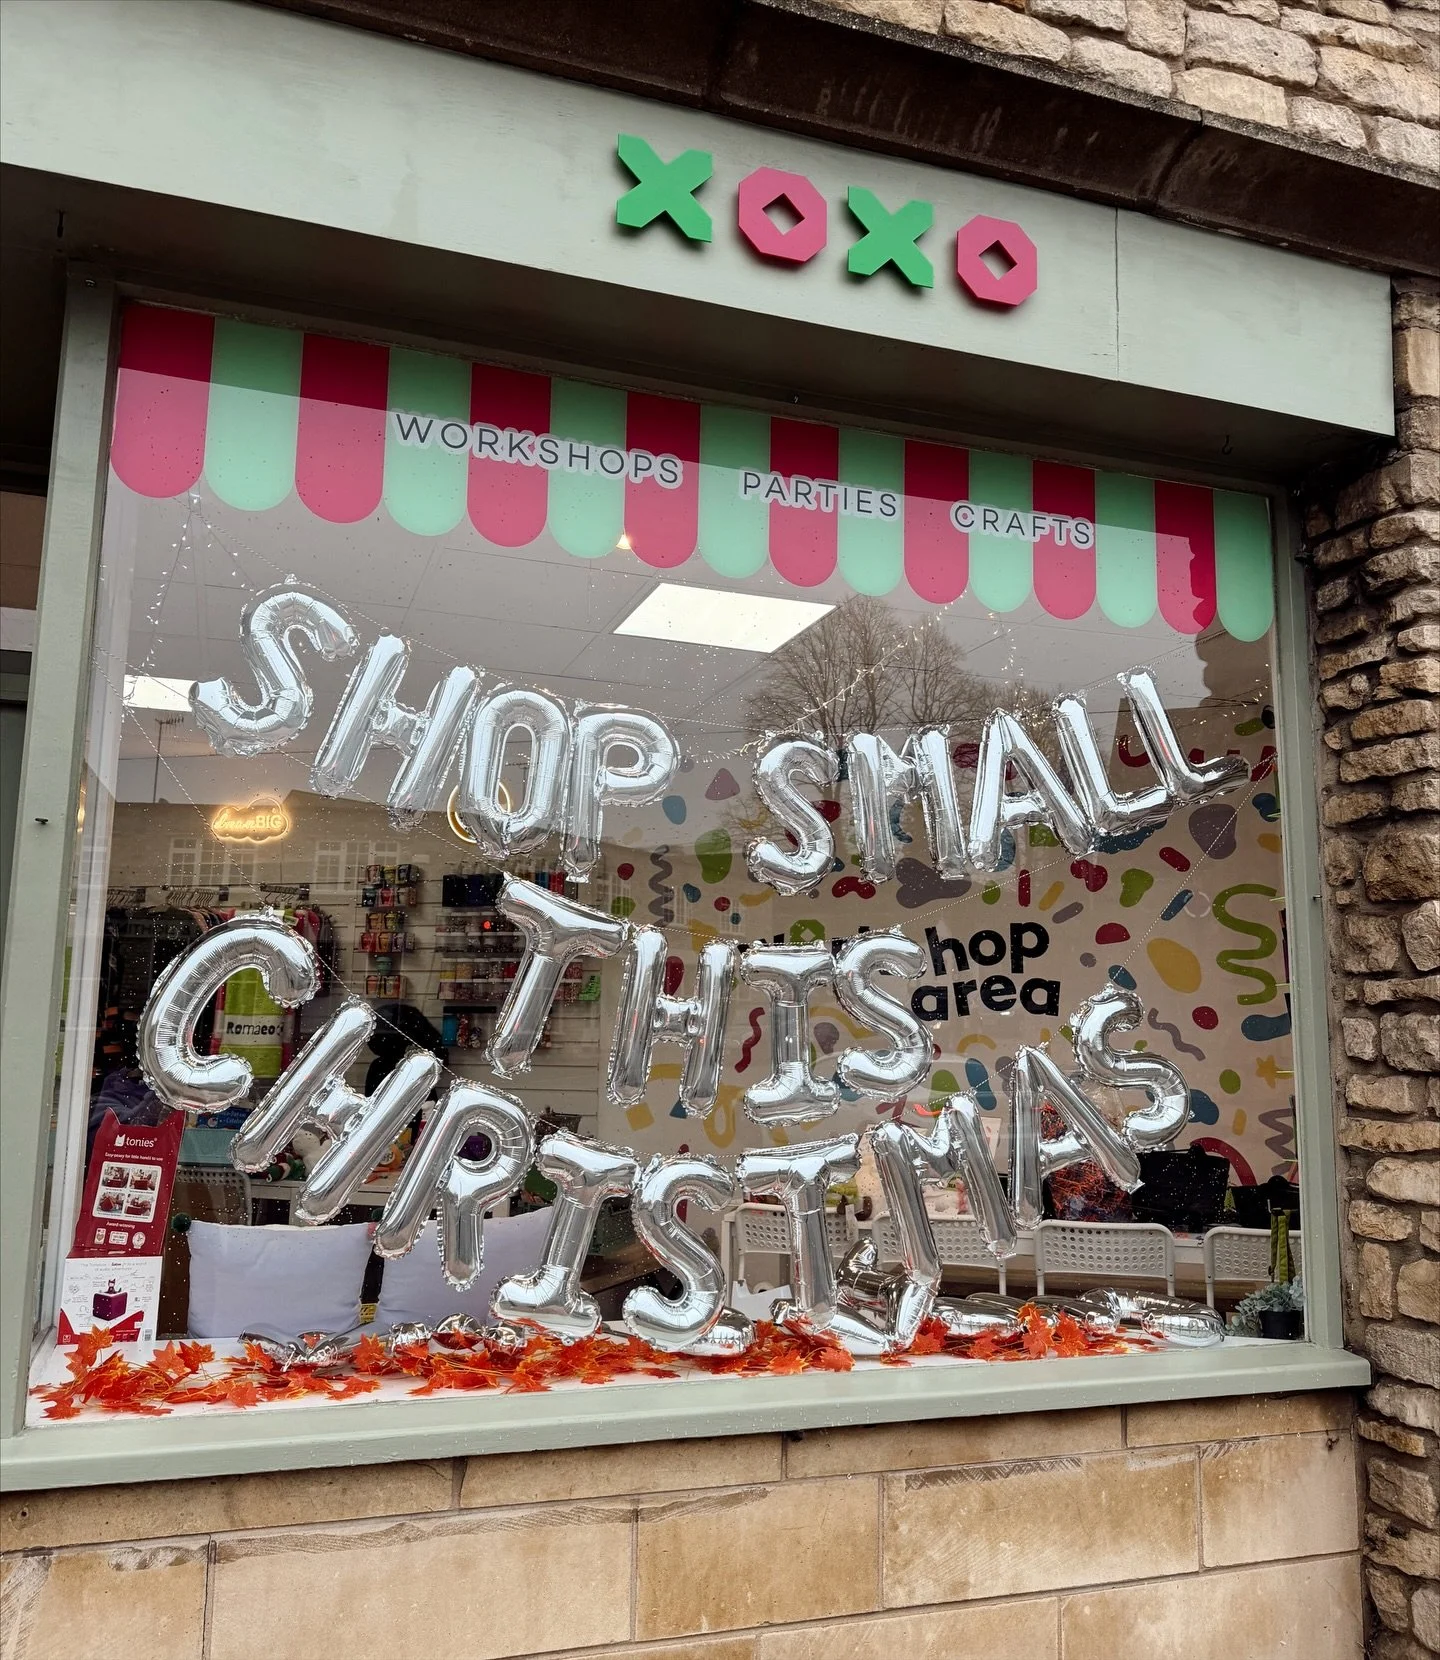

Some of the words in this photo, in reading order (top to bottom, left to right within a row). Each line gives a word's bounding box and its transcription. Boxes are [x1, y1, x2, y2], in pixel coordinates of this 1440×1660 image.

[617, 134, 1038, 308] XOXO
[394, 412, 682, 486] WORKSHOPS
[742, 471, 899, 518] PARTIES
[955, 503, 1093, 547] CRAFTS
[188, 576, 680, 882] SHOP
[746, 666, 1250, 896] SMALL
[485, 874, 934, 1124] THIS
[911, 974, 1061, 1022] area
[126, 1137, 154, 1148] tonies
[137, 910, 1190, 1354] CHRISTMAS
